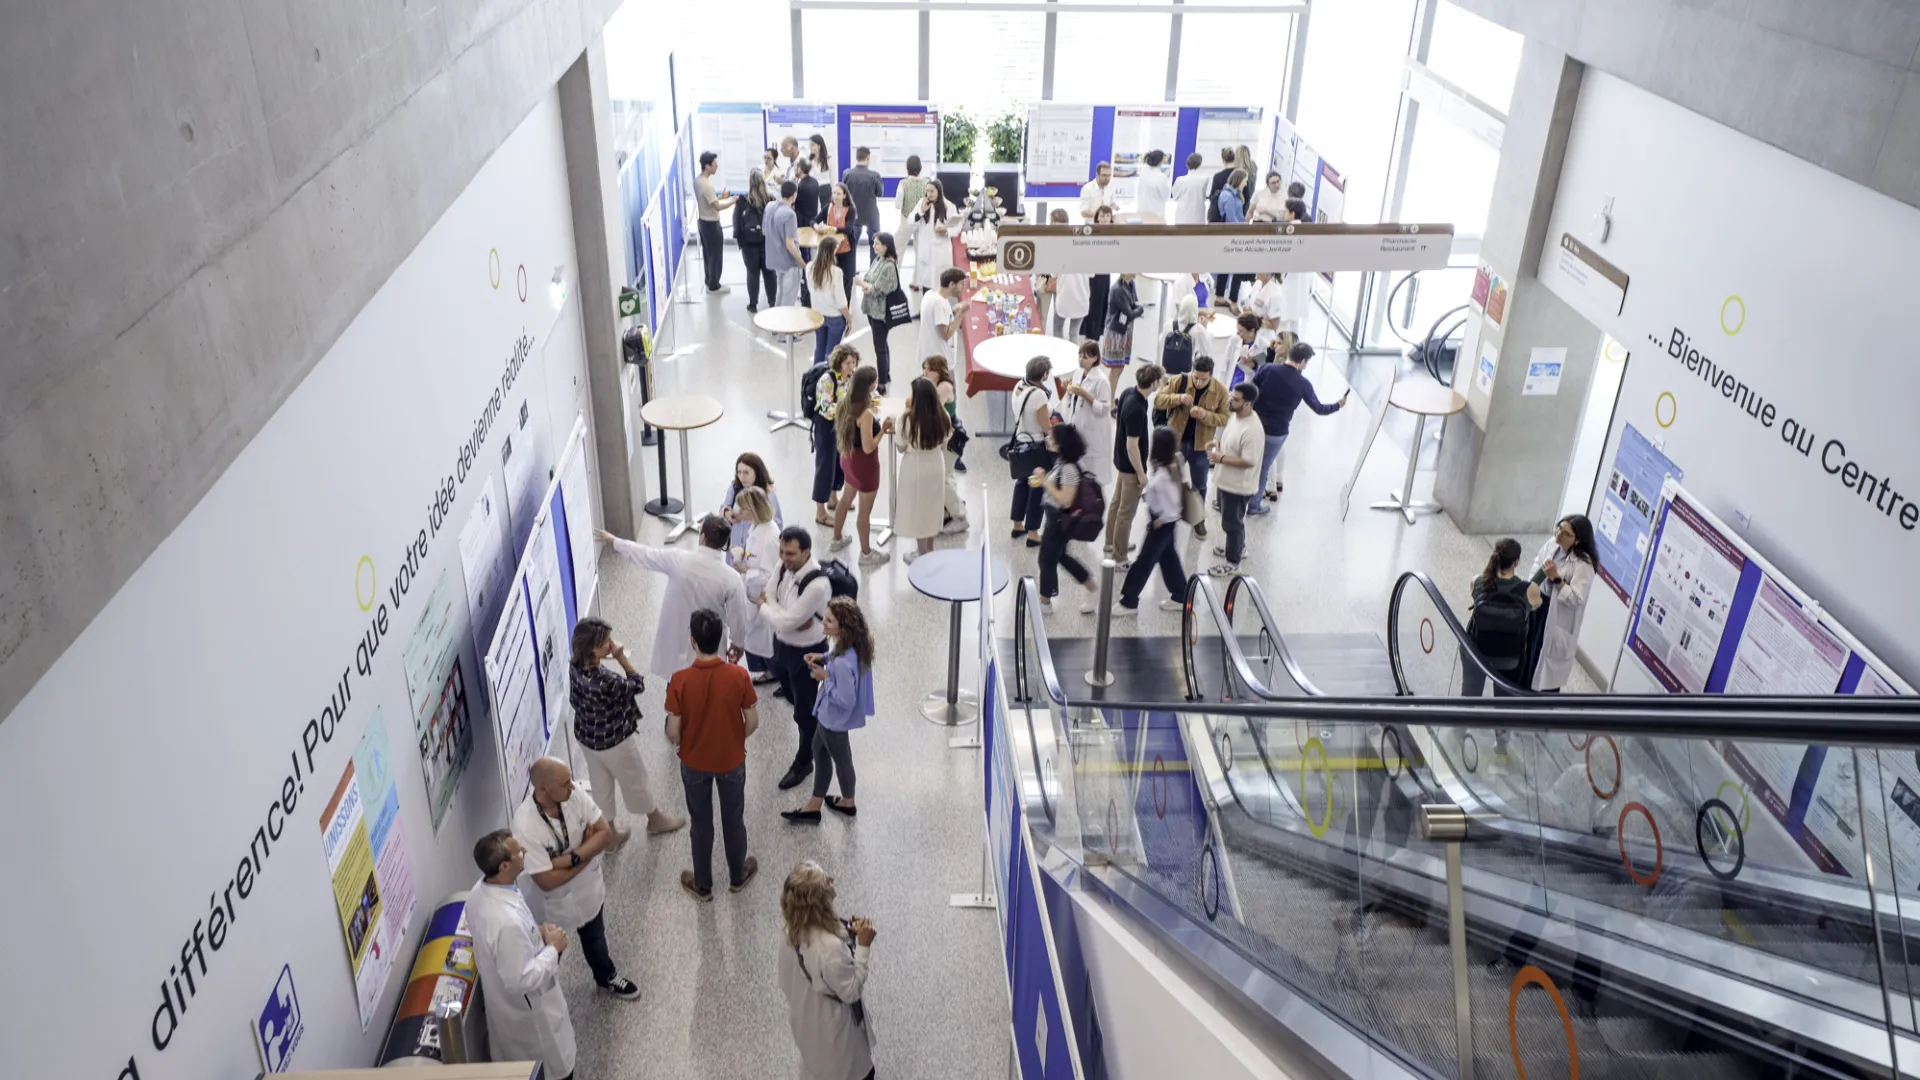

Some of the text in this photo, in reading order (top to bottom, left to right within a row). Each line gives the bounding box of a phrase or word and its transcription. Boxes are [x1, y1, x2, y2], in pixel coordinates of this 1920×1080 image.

[1014, 247, 1025, 262] 0
[1782, 417, 1815, 457] au
[1821, 439, 1920, 531] Centre
[152, 750, 304, 1052] différence!
[302, 665, 352, 775] Pour
[356, 603, 389, 677] que
[389, 528, 428, 610] votre
[427, 475, 456, 539] idée
[456, 386, 502, 485] devienne
[324, 781, 360, 858] UNISSONS
